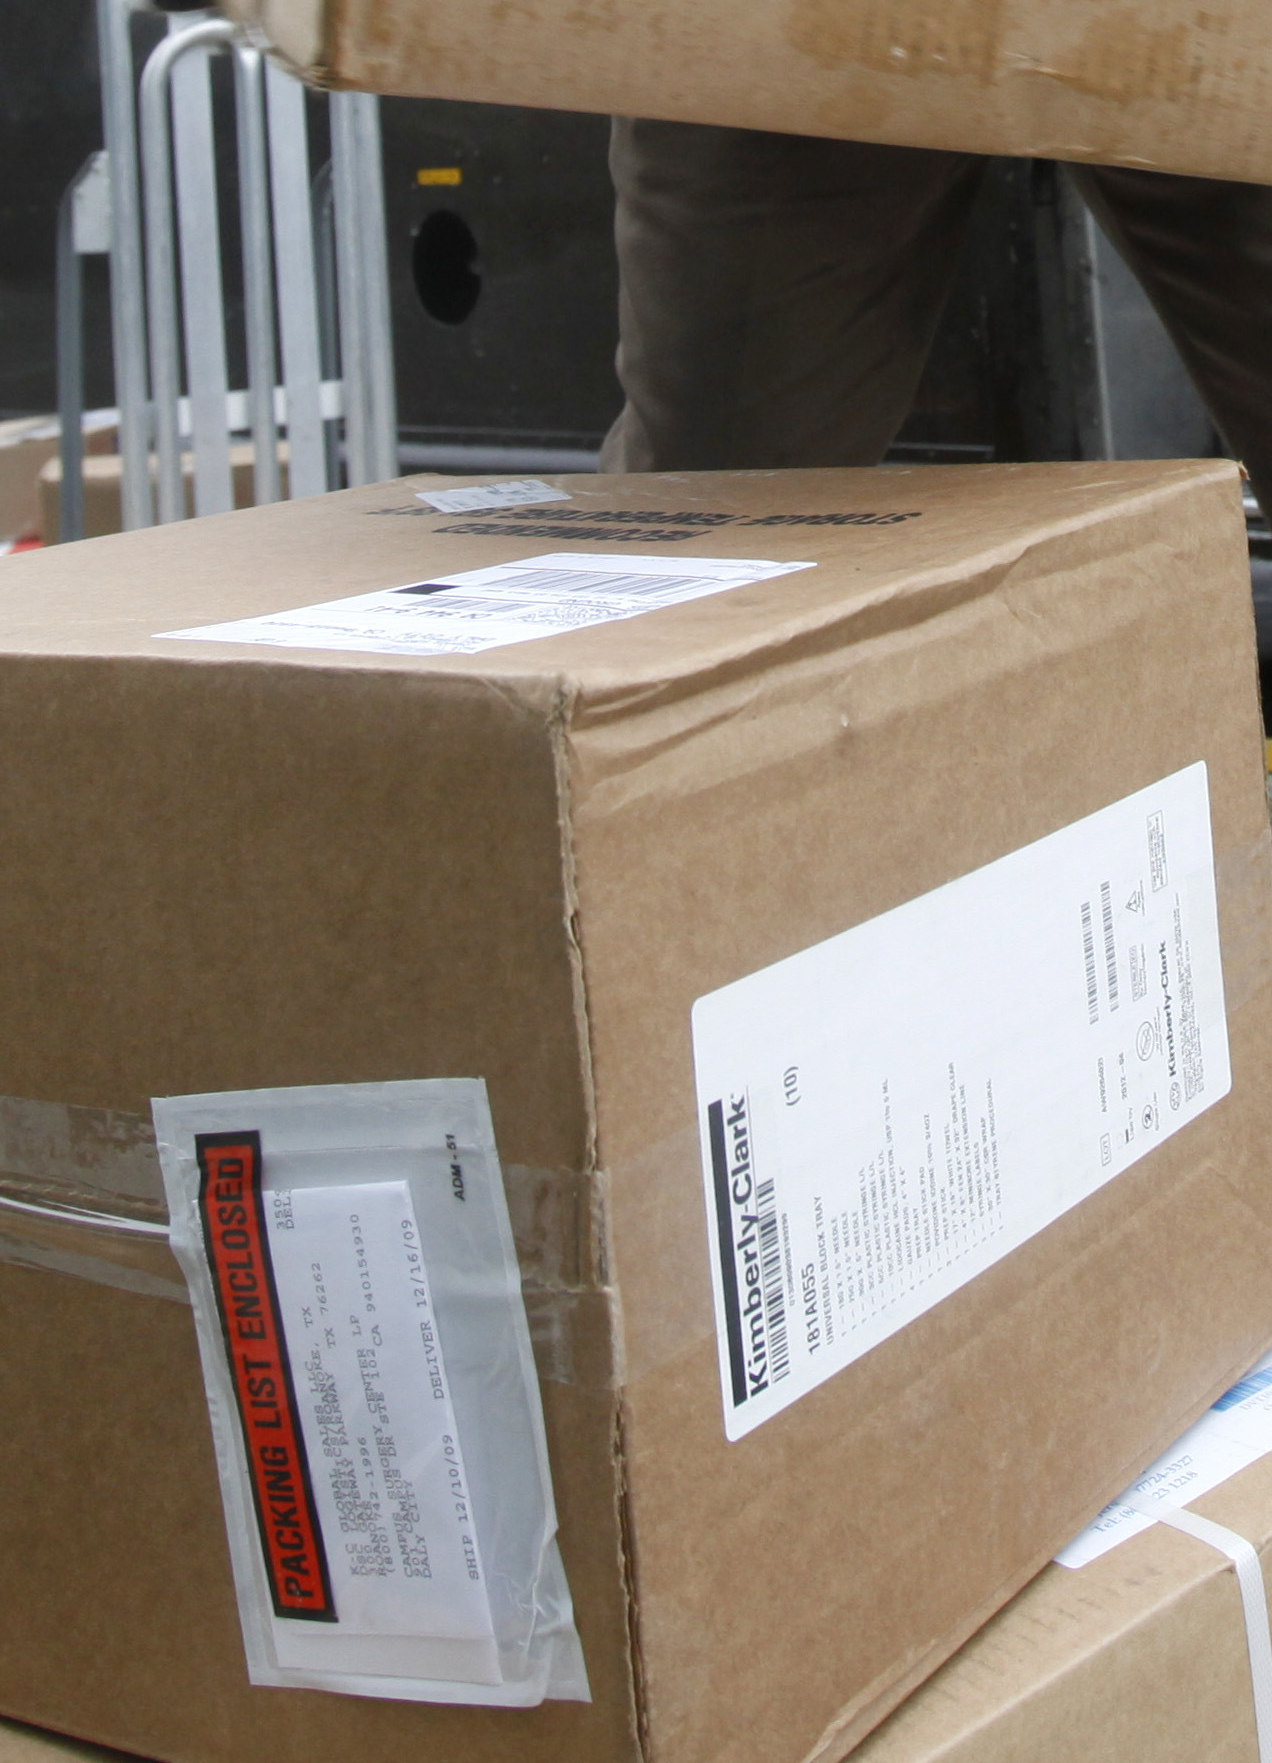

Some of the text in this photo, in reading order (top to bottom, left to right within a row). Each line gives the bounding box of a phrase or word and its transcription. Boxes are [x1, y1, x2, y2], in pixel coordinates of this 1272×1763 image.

[432, 523, 712, 541] RECOMMENDED
[497, 509, 750, 526] TEMPERATURE
[738, 512, 921, 526] STORAGE
[1158, 938, 1177, 1079] Kimberly-Clark
[947, 1060, 956, 1092] CLEAR
[958, 1083, 966, 1106] LINE
[1119, 1073, 1127, 1101] 2012
[950, 1092, 958, 1124] DRAPE
[943, 1122, 951, 1155] TOWEL
[960, 1104, 970, 1157] EXTENSION
[979, 1115, 987, 1145] WRAP
[985, 1076, 1001, 1206] TRAY STYRENE PROCEDURAL
[449, 1163, 465, 1201] ADM
[878, 1167, 888, 1210] SYRINGE
[927, 1165, 936, 1198] IODINE
[946, 1156, 954, 1188] WHITE
[972, 1140, 984, 1218] SYRINGE LABELS
[782, 1062, 821, 1357] 181A055 (10)
[859, 1184, 869, 1228] SYRINGE
[869, 1178, 879, 1222] SYRINGE
[919, 1186, 928, 1216] STICK
[939, 1185, 949, 1242] PREP STICK
[830, 1215, 840, 1255] NEEDLE
[840, 1210, 850, 1249] NEEDLE
[851, 1209, 860, 1248] NEEDLE
[872, 1221, 882, 1264] PLASTIC
[882, 1211, 891, 1252] PLASTIC
[911, 1205, 922, 1260] PREP TRAY
[922, 1216, 931, 1254] NEEDLE
[930, 1199, 940, 1248] POVIDONE
[726, 1092, 769, 1399] Kimberly-Clark
[863, 1227, 872, 1270] PLASTIC
[893, 1220, 903, 1273] LIDOCAINE
[904, 1233, 912, 1267] GAUZE
[813, 1192, 834, 1346] UNIVERSAL BLOCK TRAY
[301, 1306, 313, 1327] TX
[214, 1157, 313, 1598] PACKING LIST ENCLOSED
[366, 1348, 380, 1377] 102
[325, 1372, 348, 1444] PARKWAY
[349, 1213, 432, 1578] DALY CITY CA 940154930
[374, 1391, 389, 1423] STE
[400, 1218, 479, 1580] SHIP 12/10/09 DELIVER 12/16/09
[311, 1262, 386, 1576] ROANOKE TX 76262
[304, 1360, 358, 1574] K-C GLOBAL SALES LLC
[349, 1314, 413, 1577] CAMPUS SURGERY CENTER LP
[384, 1435, 397, 1456] DR
[343, 1457, 368, 1532] GATEWAY
[391, 1468, 413, 1533] CAMPUS
